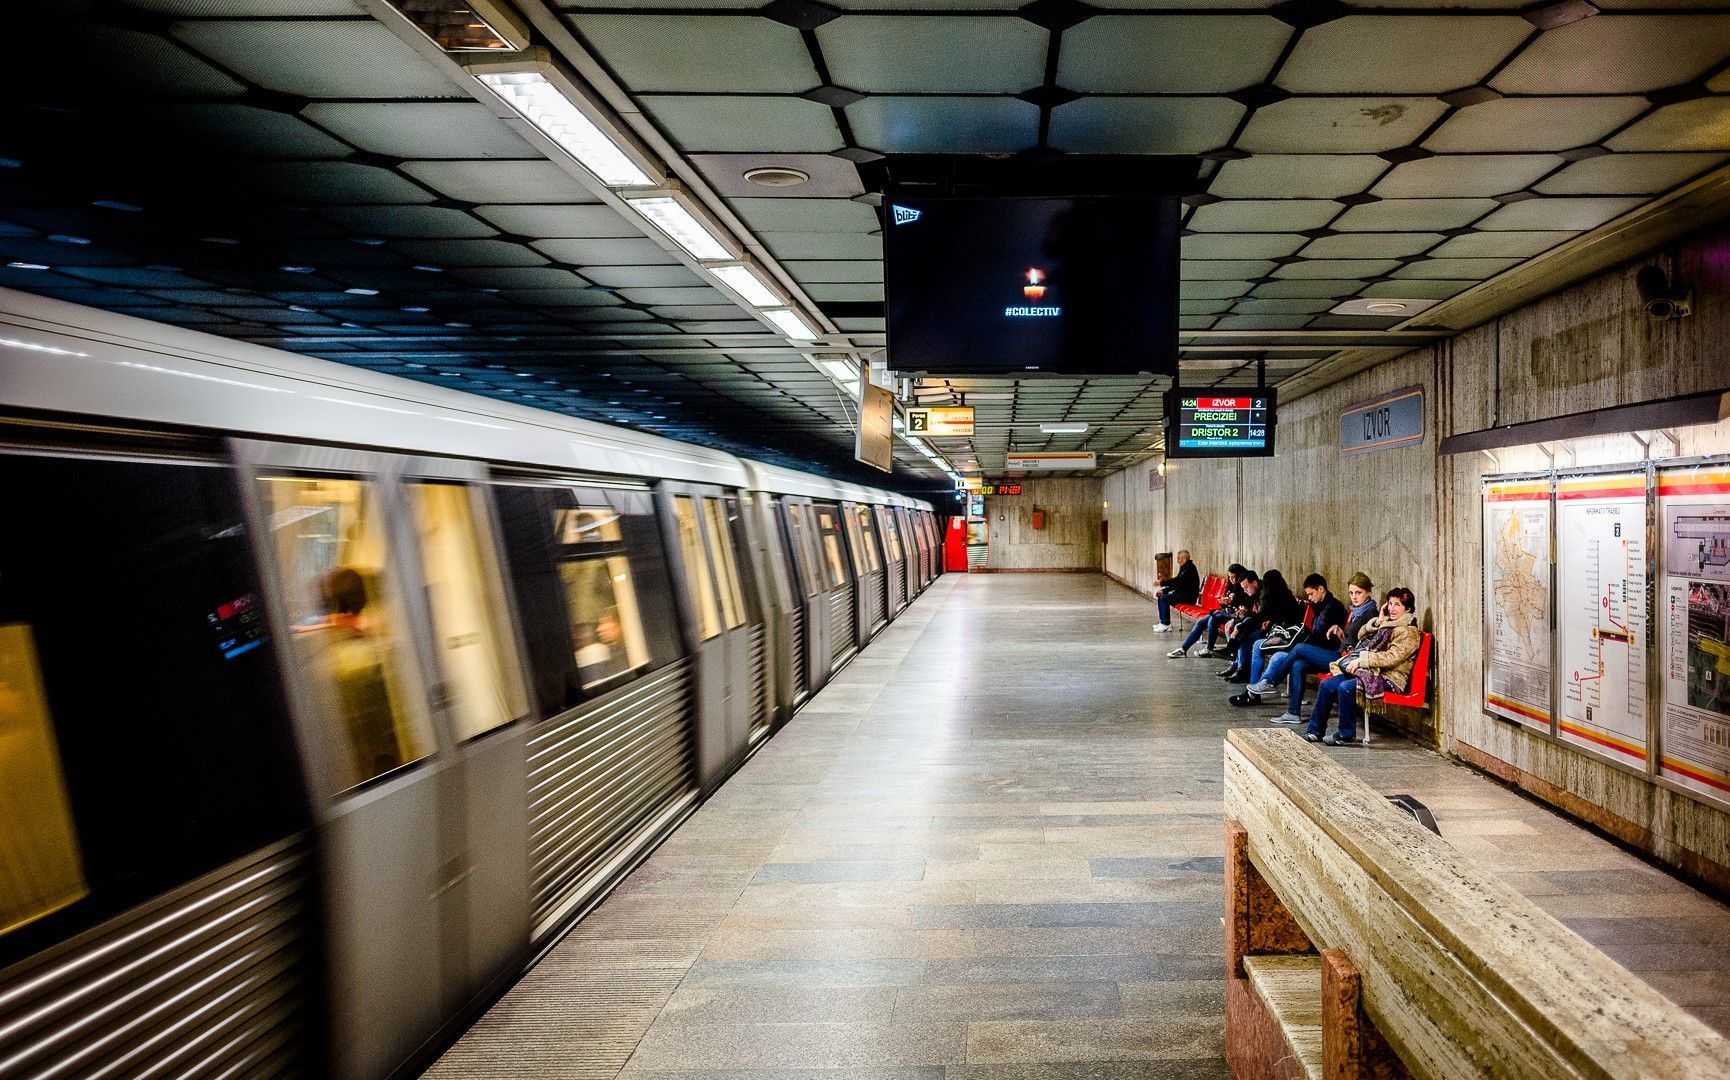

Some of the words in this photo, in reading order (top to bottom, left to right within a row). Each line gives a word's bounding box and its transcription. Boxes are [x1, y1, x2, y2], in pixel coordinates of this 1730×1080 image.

[1004, 306, 1061, 317] #COLECTIV
[1193, 412, 1237, 421] PRECIZIEI
[914, 418, 923, 430] 2
[1362, 407, 1391, 441] IZVOR
[1191, 428, 1231, 437] DRISTOR
[1232, 428, 1239, 437] 2
